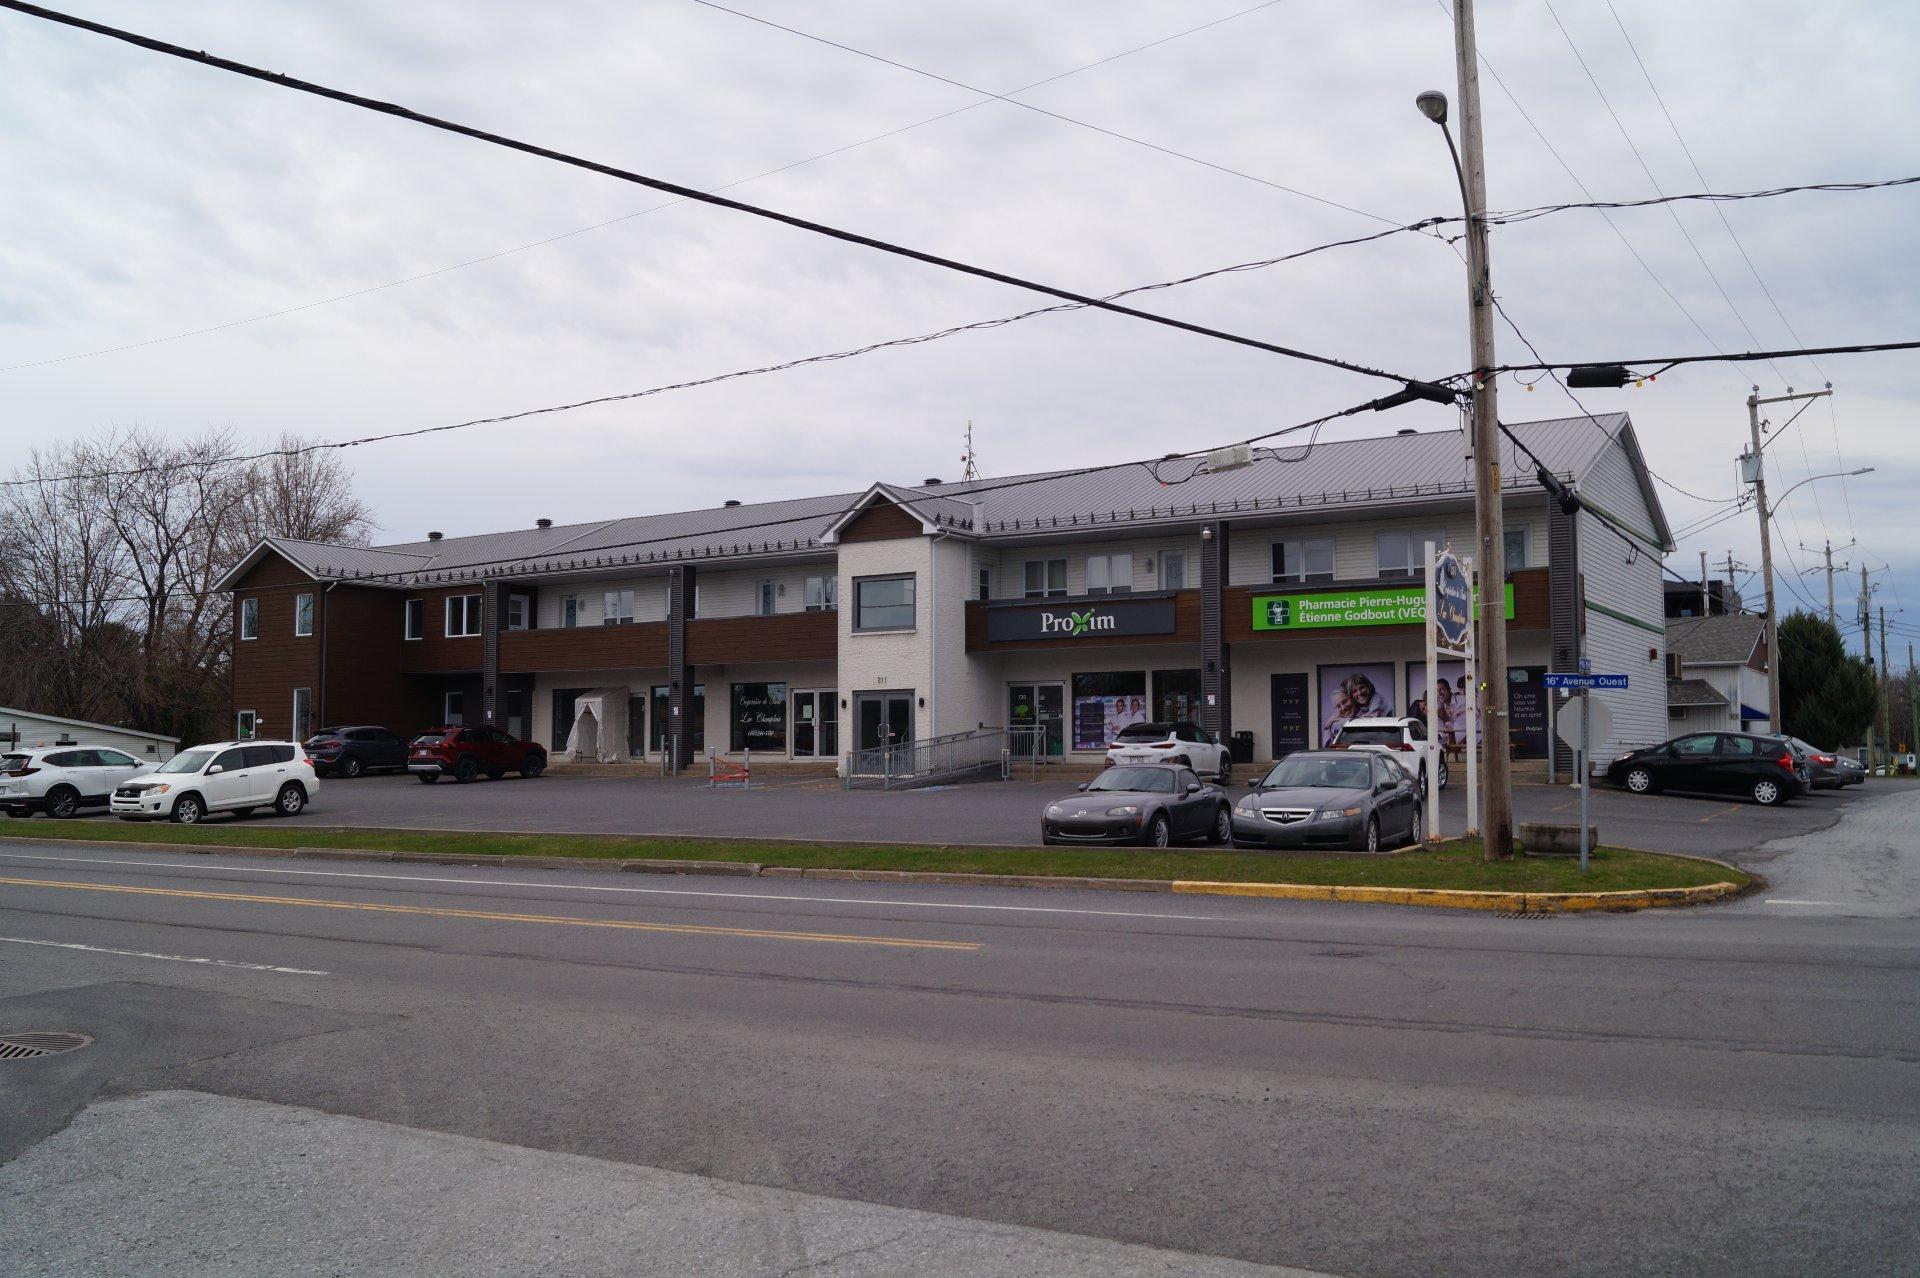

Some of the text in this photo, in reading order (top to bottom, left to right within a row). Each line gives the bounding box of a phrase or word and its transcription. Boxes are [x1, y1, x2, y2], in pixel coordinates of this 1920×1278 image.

[1299, 595, 1426, 610] Pharmacie Pierre-Hugu
[1040, 608, 1116, 636] Proxim
[1299, 607, 1426, 623] Étienne Godbout (VEQ
[1562, 677, 1595, 685] Avenue
[1599, 677, 1627, 686] Ouest
